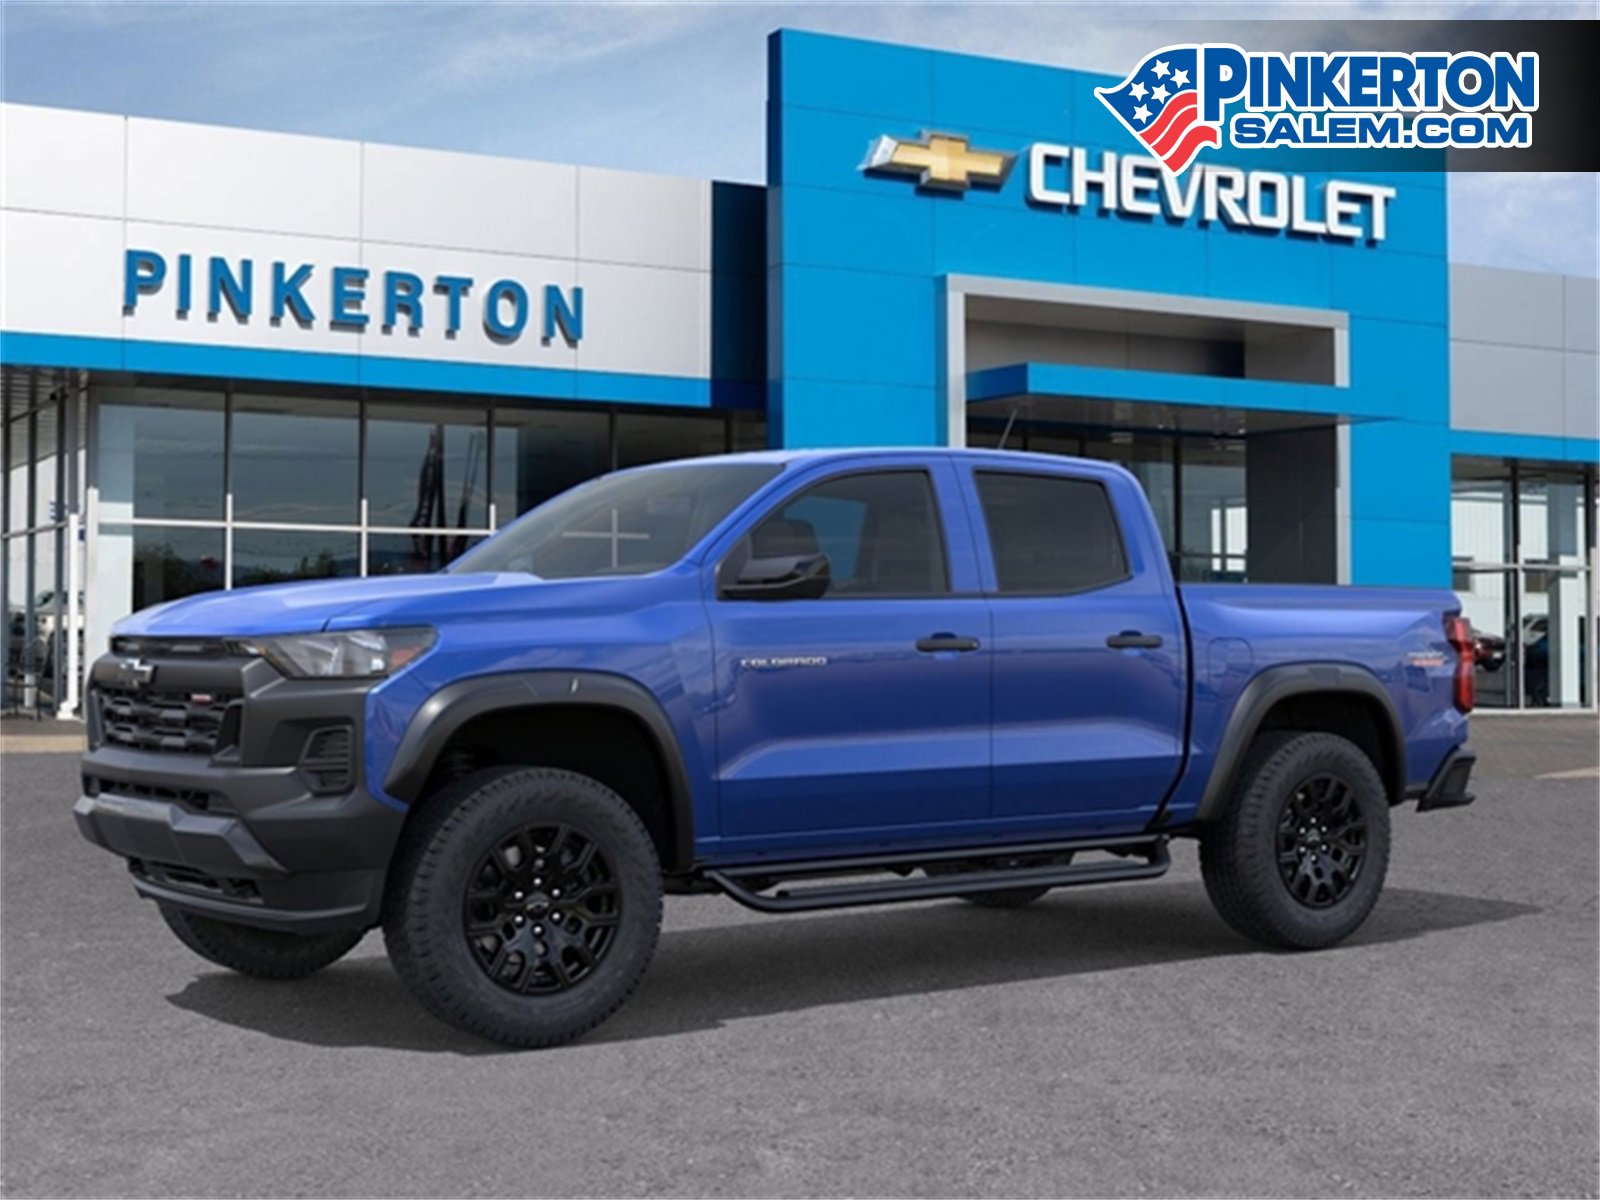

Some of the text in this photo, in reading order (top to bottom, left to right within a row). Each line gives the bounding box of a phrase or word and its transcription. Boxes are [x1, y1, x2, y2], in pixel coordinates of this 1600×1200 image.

[1029, 142, 1396, 240] CHEVROLET
[124, 249, 584, 343] PINKERTON
[740, 656, 828, 668] COLORADO
